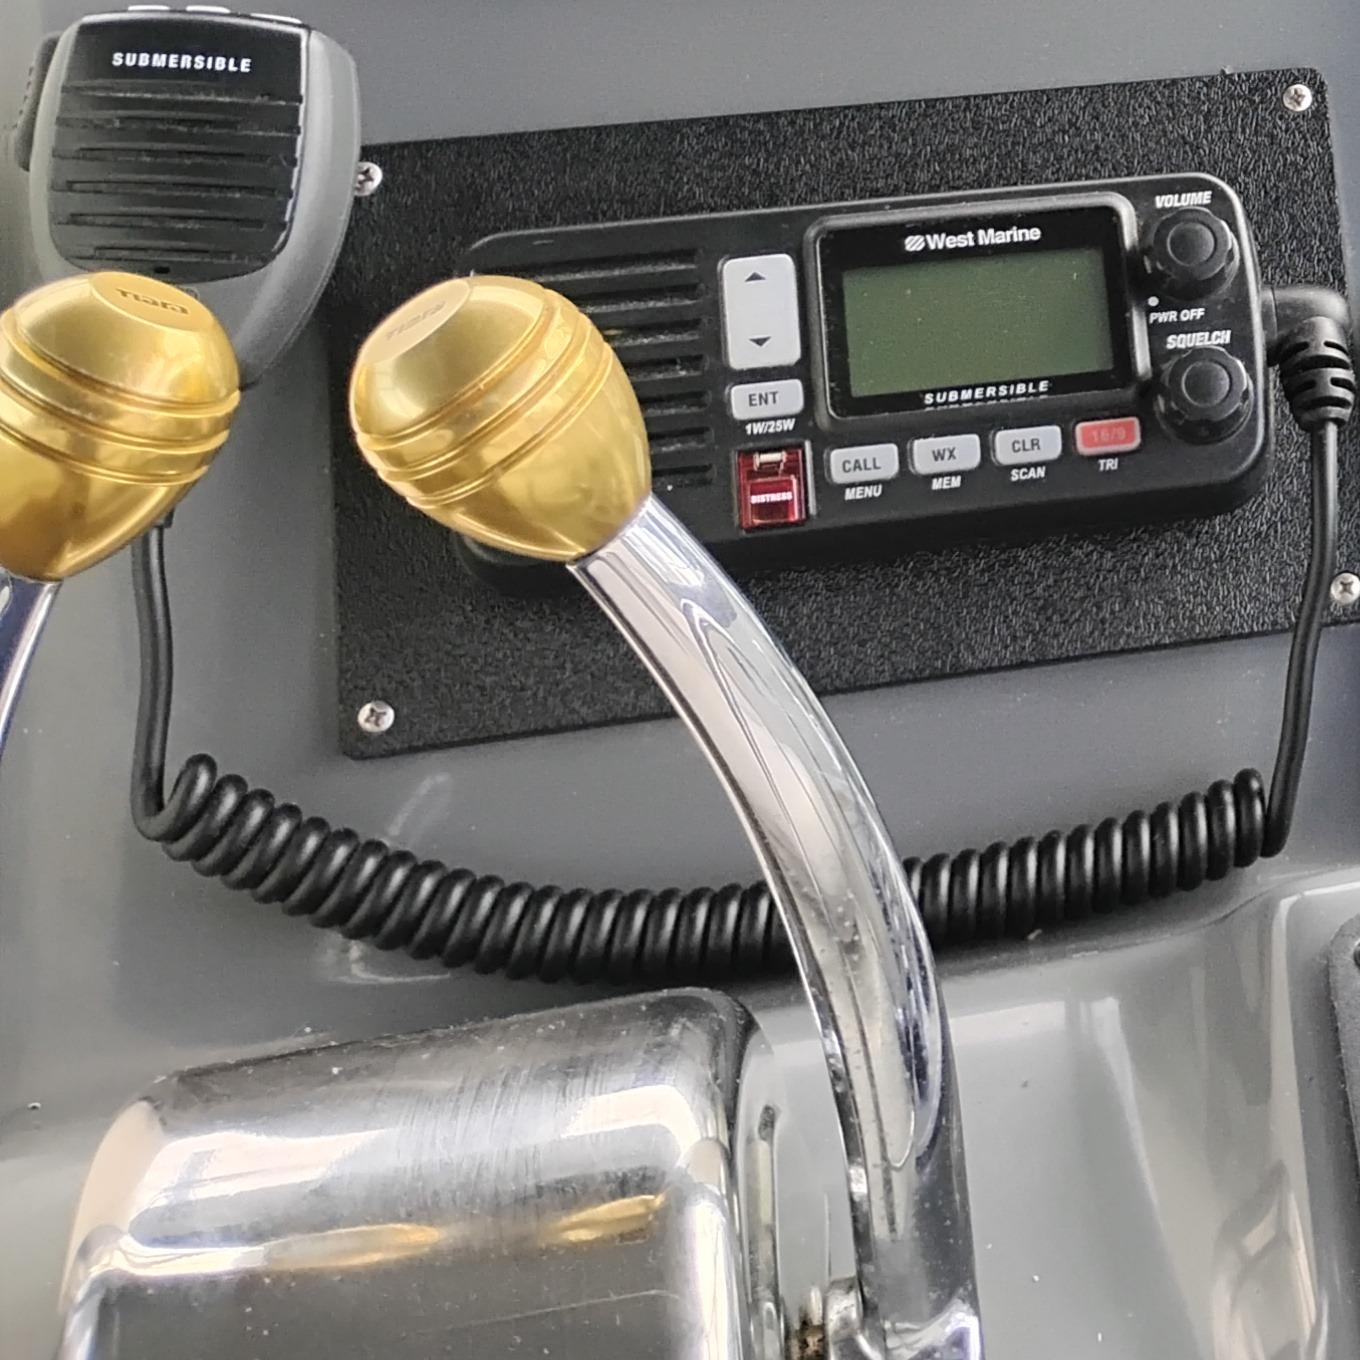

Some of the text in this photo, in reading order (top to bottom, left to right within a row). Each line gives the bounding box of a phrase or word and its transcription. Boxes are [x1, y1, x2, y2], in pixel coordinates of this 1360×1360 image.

[112, 52, 252, 73] SUBMERSIBLE
[1155, 191, 1212, 208] VOLUME
[925, 224, 1042, 250] West Marine
[1149, 308, 1205, 324] PWR OFF
[1166, 330, 1232, 349] SQUELCH
[748, 391, 779, 407] ENT
[924, 380, 1050, 404] SUBMERSIBLE
[745, 418, 796, 435] 1W/25W
[1012, 437, 1041, 453] CLR
[932, 446, 958, 463] WX
[842, 457, 881, 473] CALL
[1098, 458, 1118, 471] TRI
[1010, 466, 1046, 482] SCAN
[932, 475, 962, 491] MEM
[751, 491, 793, 504] DISTRESS
[844, 484, 883, 500] MENU
